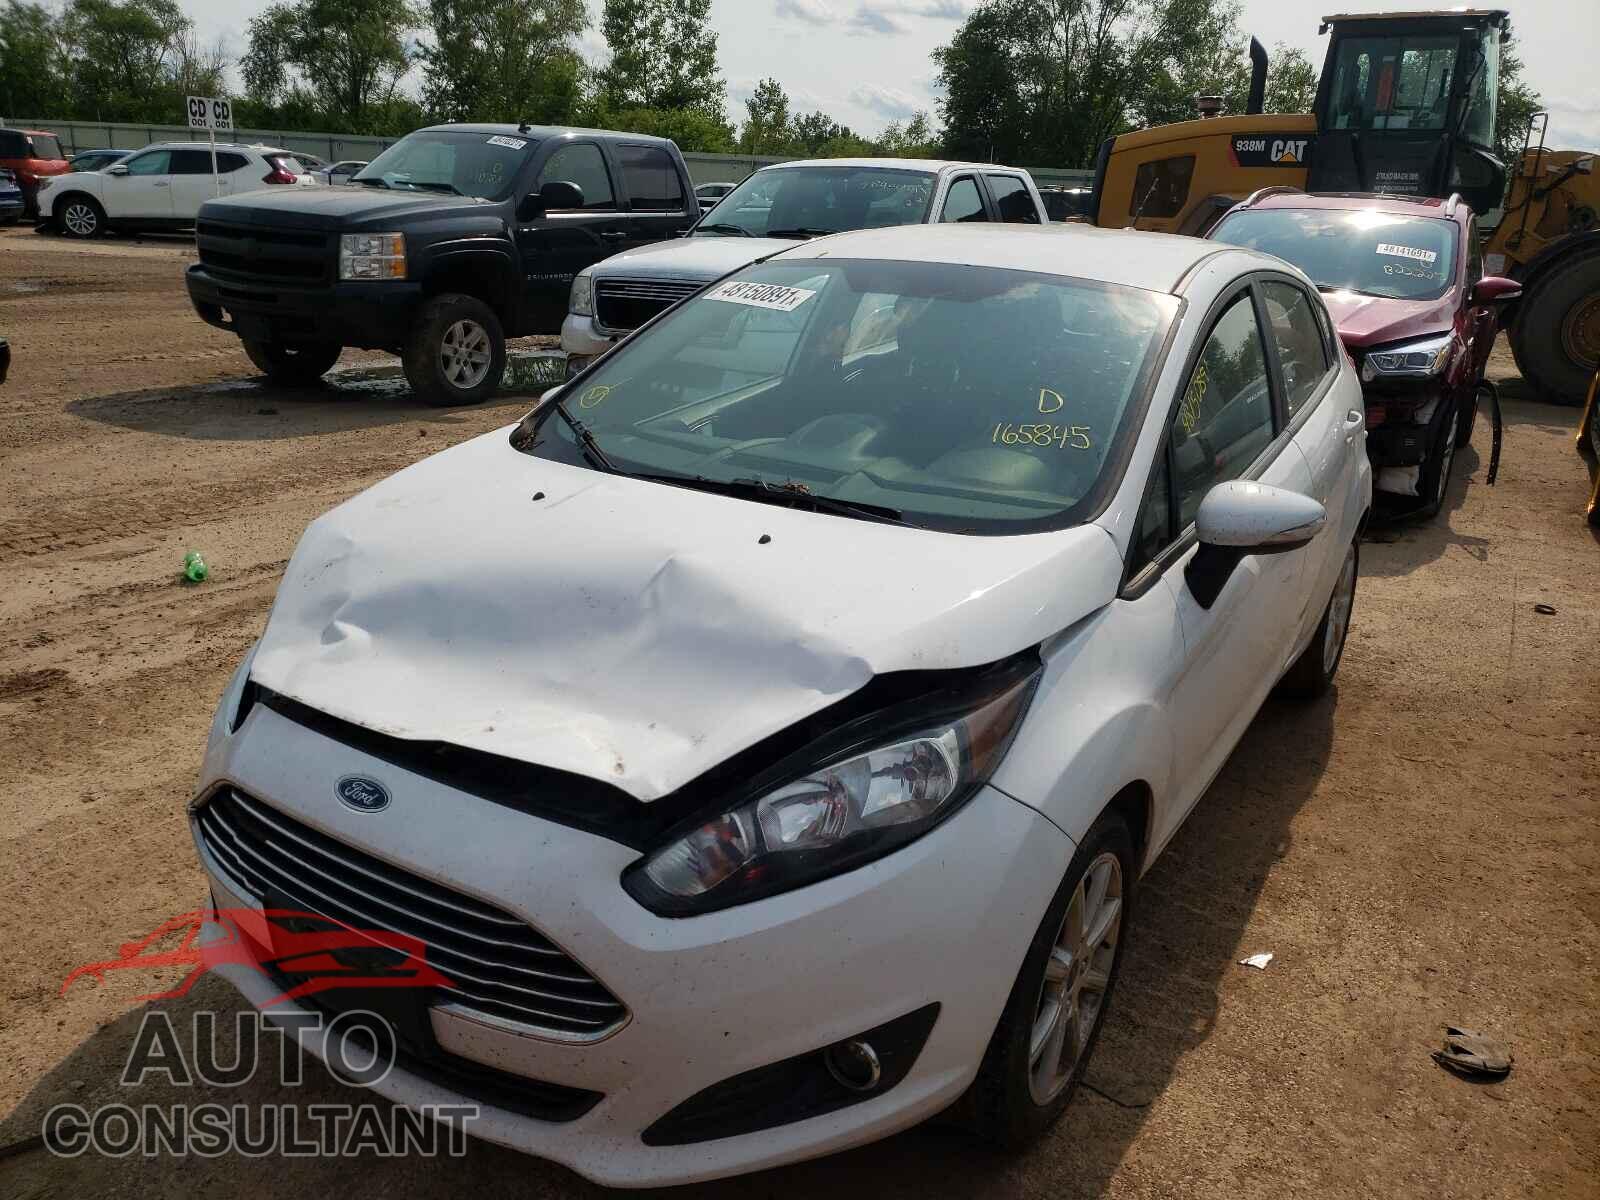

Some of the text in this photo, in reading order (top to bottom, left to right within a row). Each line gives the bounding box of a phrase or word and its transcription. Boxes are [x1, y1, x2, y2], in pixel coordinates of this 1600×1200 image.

[190, 98, 206, 117] CD
[213, 101, 230, 120] CD
[191, 118, 207, 127] 001
[215, 120, 230, 128] 001
[1236, 140, 1266, 152] 938M
[1270, 139, 1308, 162] CAT
[1038, 388, 1064, 413] D
[992, 422, 1091, 449] 165845
[344, 781, 380, 805] Ford
